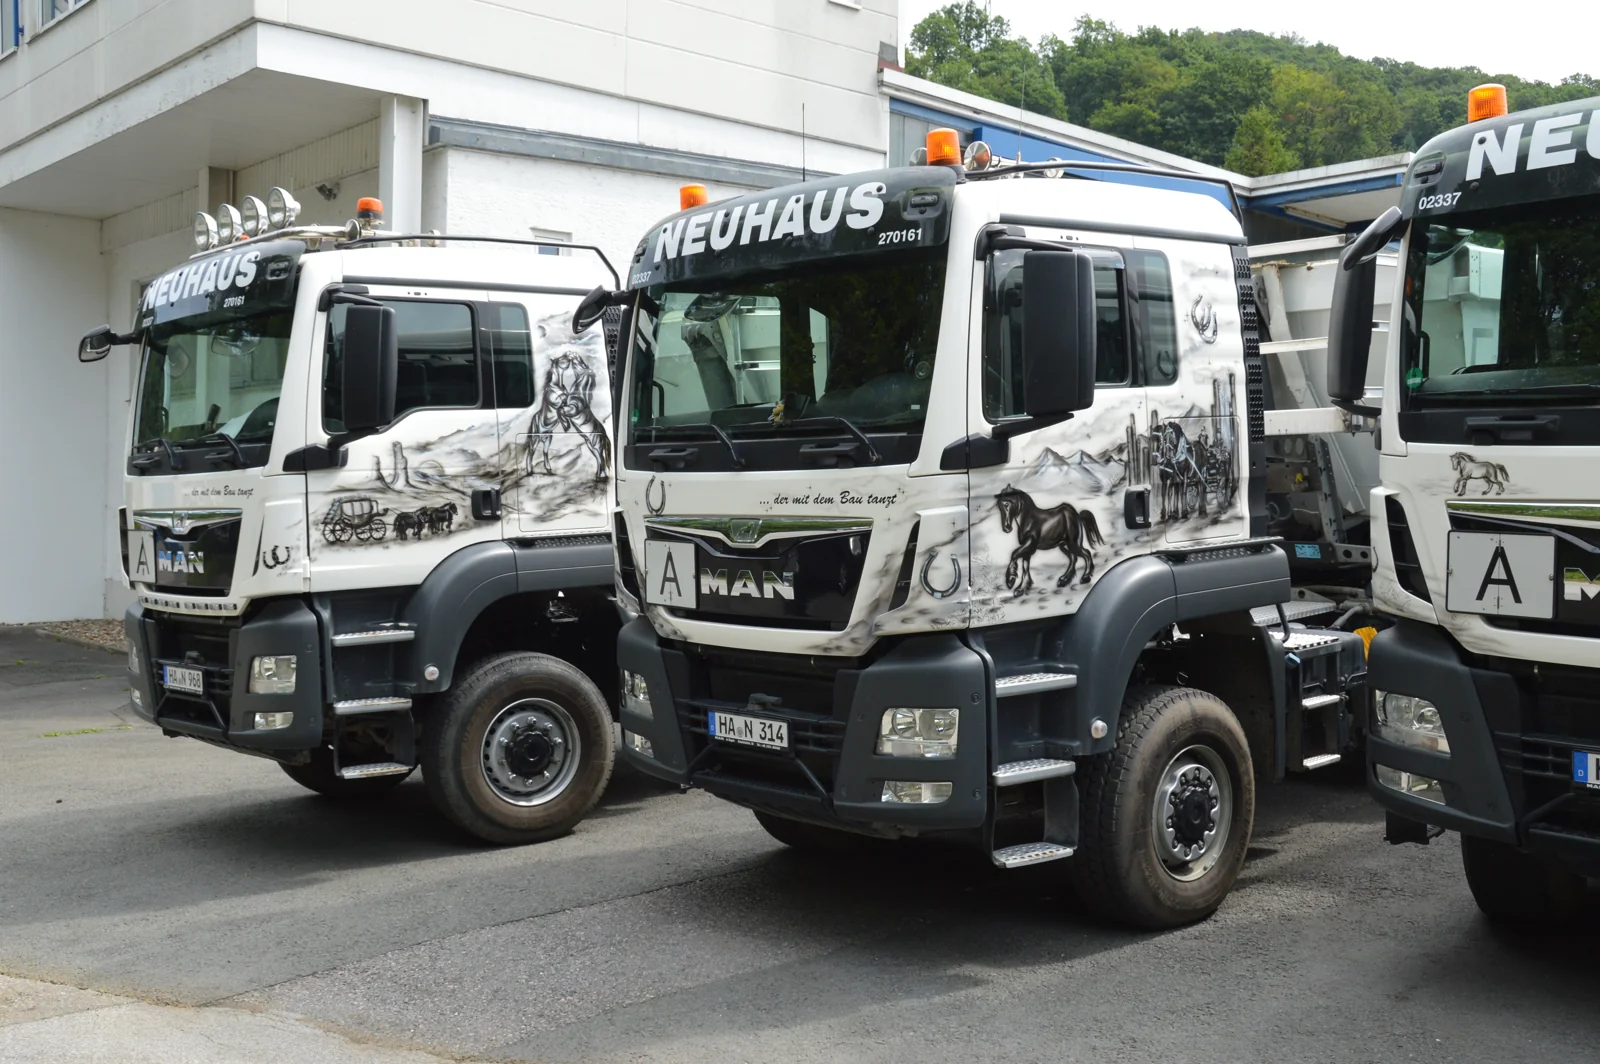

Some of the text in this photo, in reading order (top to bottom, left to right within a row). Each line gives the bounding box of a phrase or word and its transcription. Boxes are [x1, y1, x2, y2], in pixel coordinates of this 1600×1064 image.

[1418, 192, 1462, 210] 02337
[653, 182, 886, 262] NEUHAUS
[877, 228, 922, 245] 270161
[143, 251, 260, 311] NEUHAUS
[773, 493, 789, 505] der
[792, 494, 810, 505] mit
[813, 493, 835, 505] dem
[839, 490, 864, 504] Bau
[866, 493, 898, 508] tanzt
[136, 540, 150, 575] A
[158, 550, 205, 574] MAN
[660, 549, 682, 598] A
[700, 568, 795, 600] MAN
[1475, 545, 1523, 604] A
[718, 715, 736, 736] HA
[744, 719, 753, 739] N
[759, 721, 785, 744] 314
